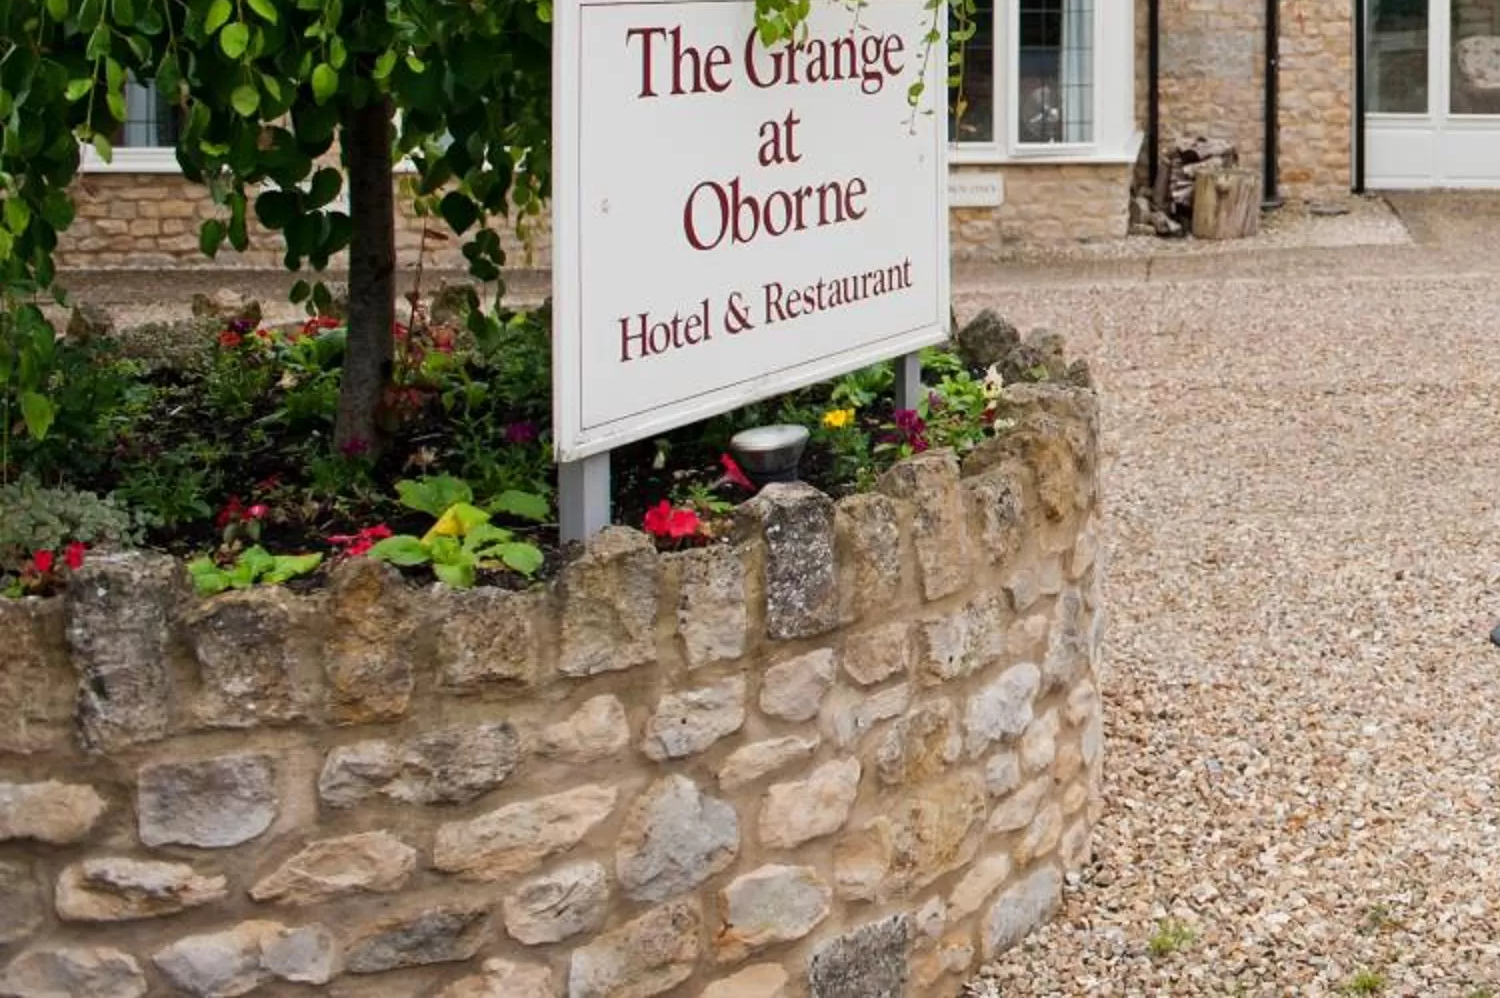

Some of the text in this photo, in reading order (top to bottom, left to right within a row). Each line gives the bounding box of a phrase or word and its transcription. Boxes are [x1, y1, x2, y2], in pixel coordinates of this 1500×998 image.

[626, 24, 905, 99] The Grange
[758, 108, 802, 168] at
[683, 175, 868, 252] Oborne
[618, 257, 914, 363] Hotel & Restaurant
